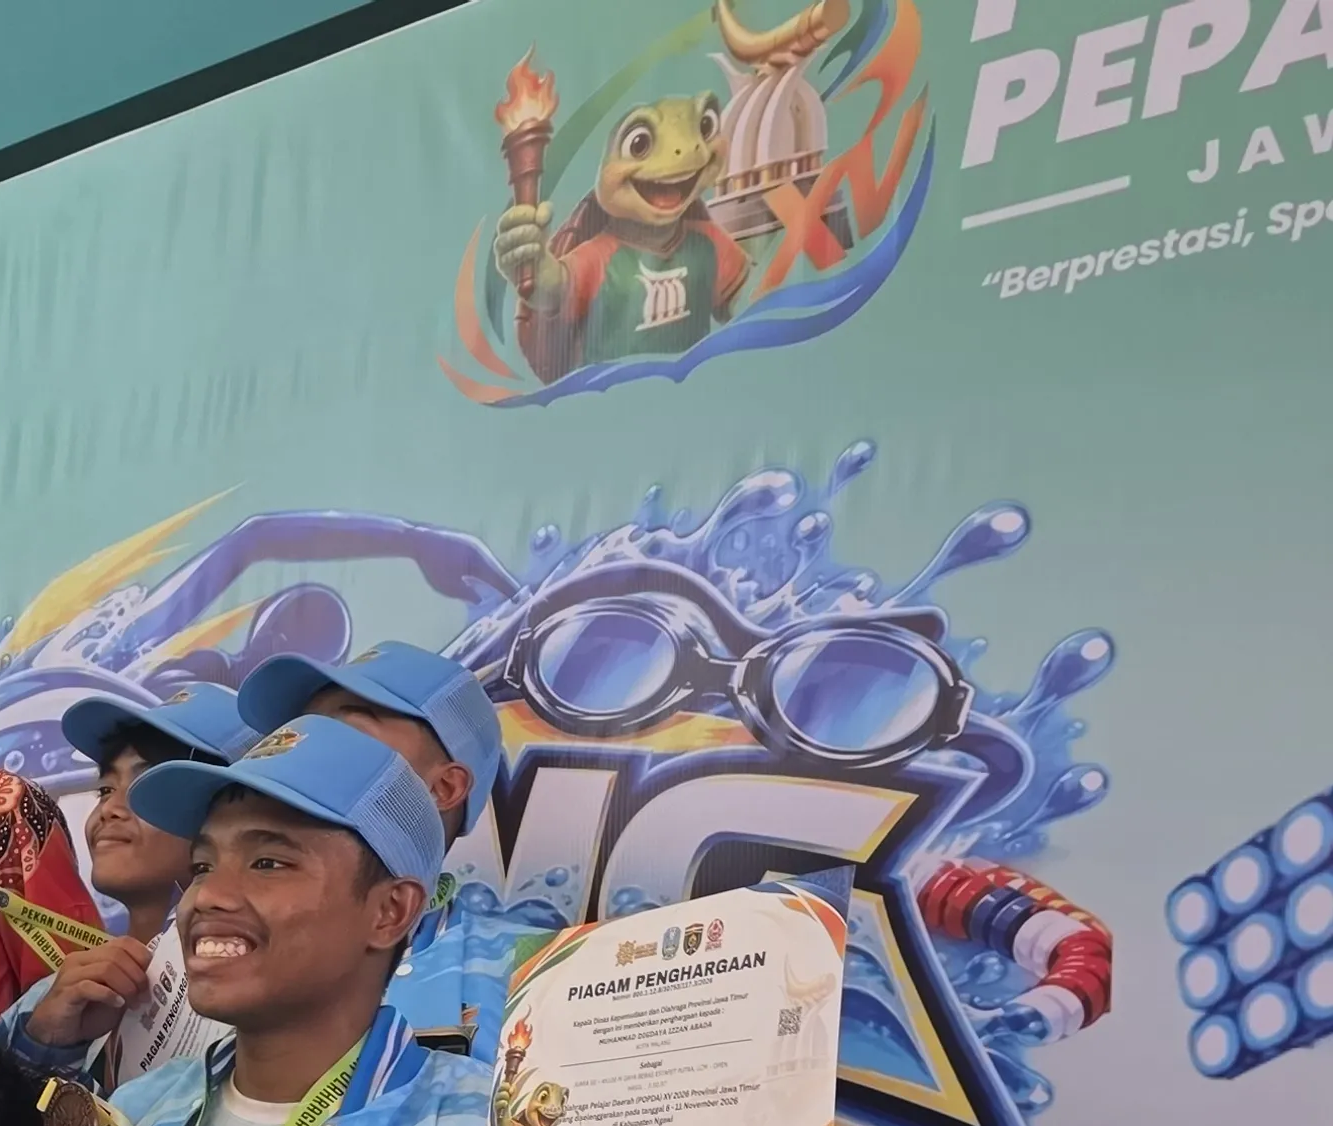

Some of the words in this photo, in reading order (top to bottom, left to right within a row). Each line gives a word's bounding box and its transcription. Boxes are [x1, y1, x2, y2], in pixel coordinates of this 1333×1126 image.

[21, 906, 54, 928] PEKAN
[568, 977, 631, 1001] PIAGAM
[635, 951, 767, 990] PENGHARGAAN
[713, 996, 729, 1005] Jawa
[730, 993, 749, 1002] Timur
[660, 1012, 698, 1025] penghargaan
[699, 1009, 721, 1020] kepada
[140, 1029, 166, 1071] PIAGAM
[639, 1059, 663, 1070] Sebagai
[590, 1099, 612, 1110] Pelajar
[612, 1097, 635, 1108] Daerah
[636, 1093, 663, 1104] (POPDA)
[663, 1092, 673, 1101] XV
[673, 1090, 690, 1099] 2026
[690, 1085, 718, 1097] Provinsi
[719, 1084, 738, 1094] Jawa
[739, 1083, 761, 1092] Timur
[624, 1108, 640, 1118] pada
[641, 1105, 665, 1117] tanggal
[683, 1098, 719, 1110] November
[720, 1097, 738, 1106] 2026
[654, 1115, 674, 1126] Ngawi
